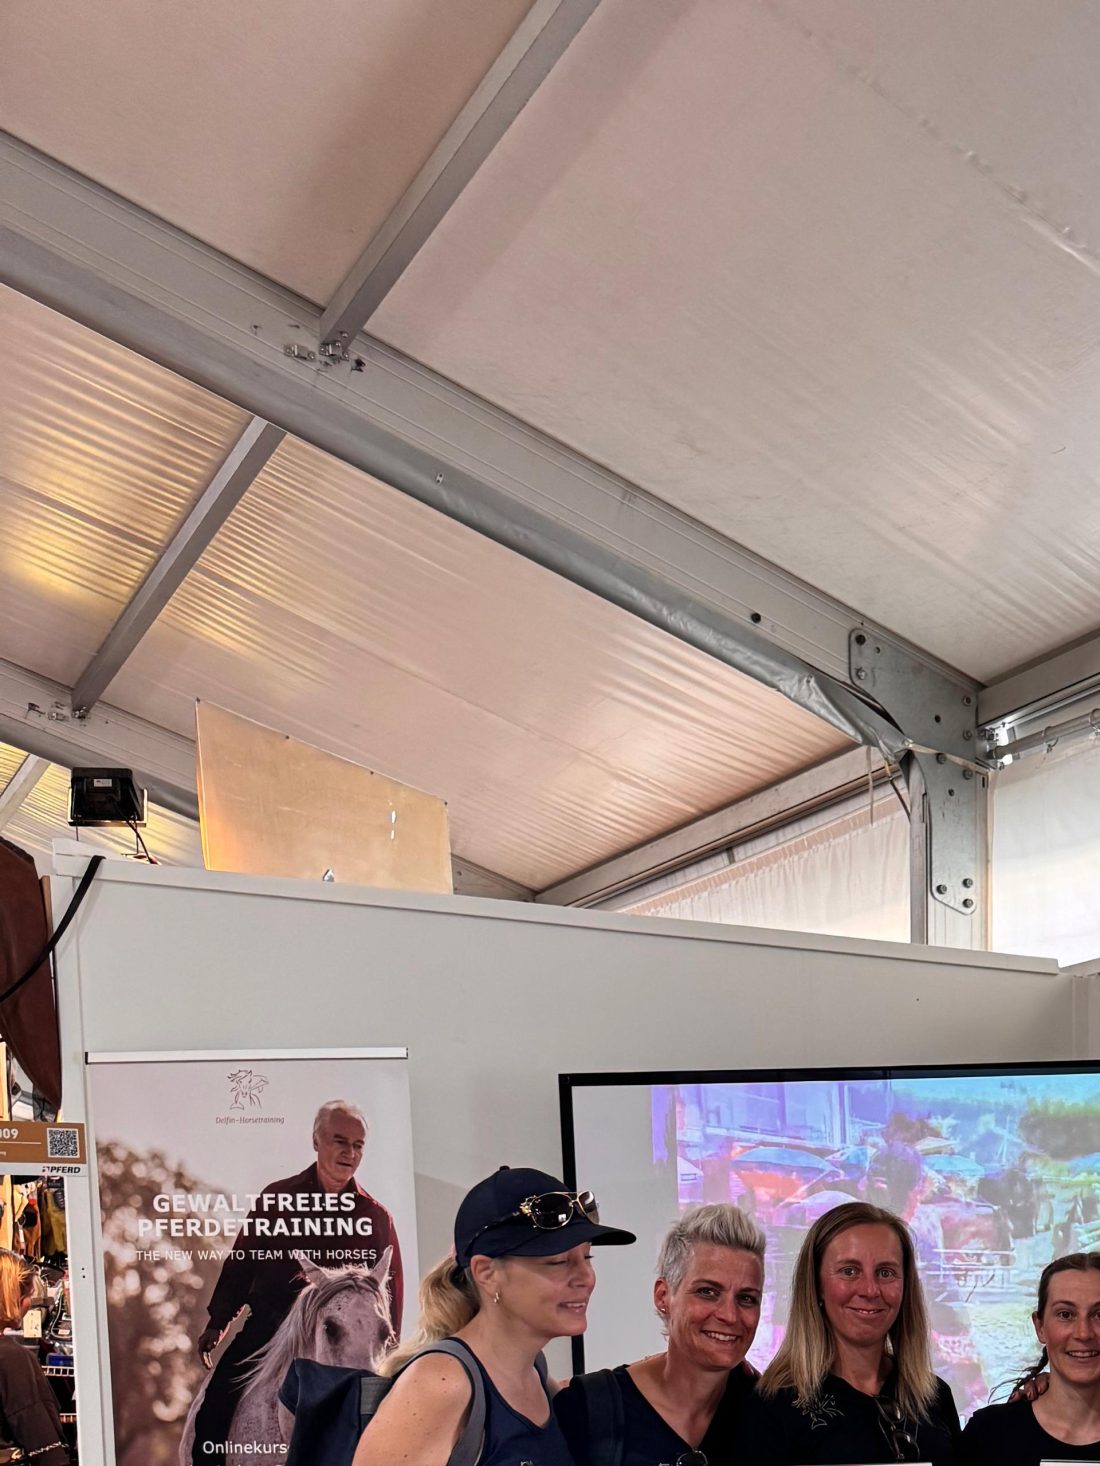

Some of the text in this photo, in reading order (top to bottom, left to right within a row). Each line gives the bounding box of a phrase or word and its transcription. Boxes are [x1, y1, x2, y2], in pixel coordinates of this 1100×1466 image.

[215, 1116, 285, 1125] Delfin-Horsetraining
[50, 1166, 81, 1174] PFERD
[152, 1192, 356, 1213] GEWALTFREIES
[138, 1217, 374, 1238] PFERDETRAINING
[135, 1248, 378, 1262] THE NEW WAY TO TEAM WITH HORSES
[202, 1440, 290, 1454] Onlinekurs
